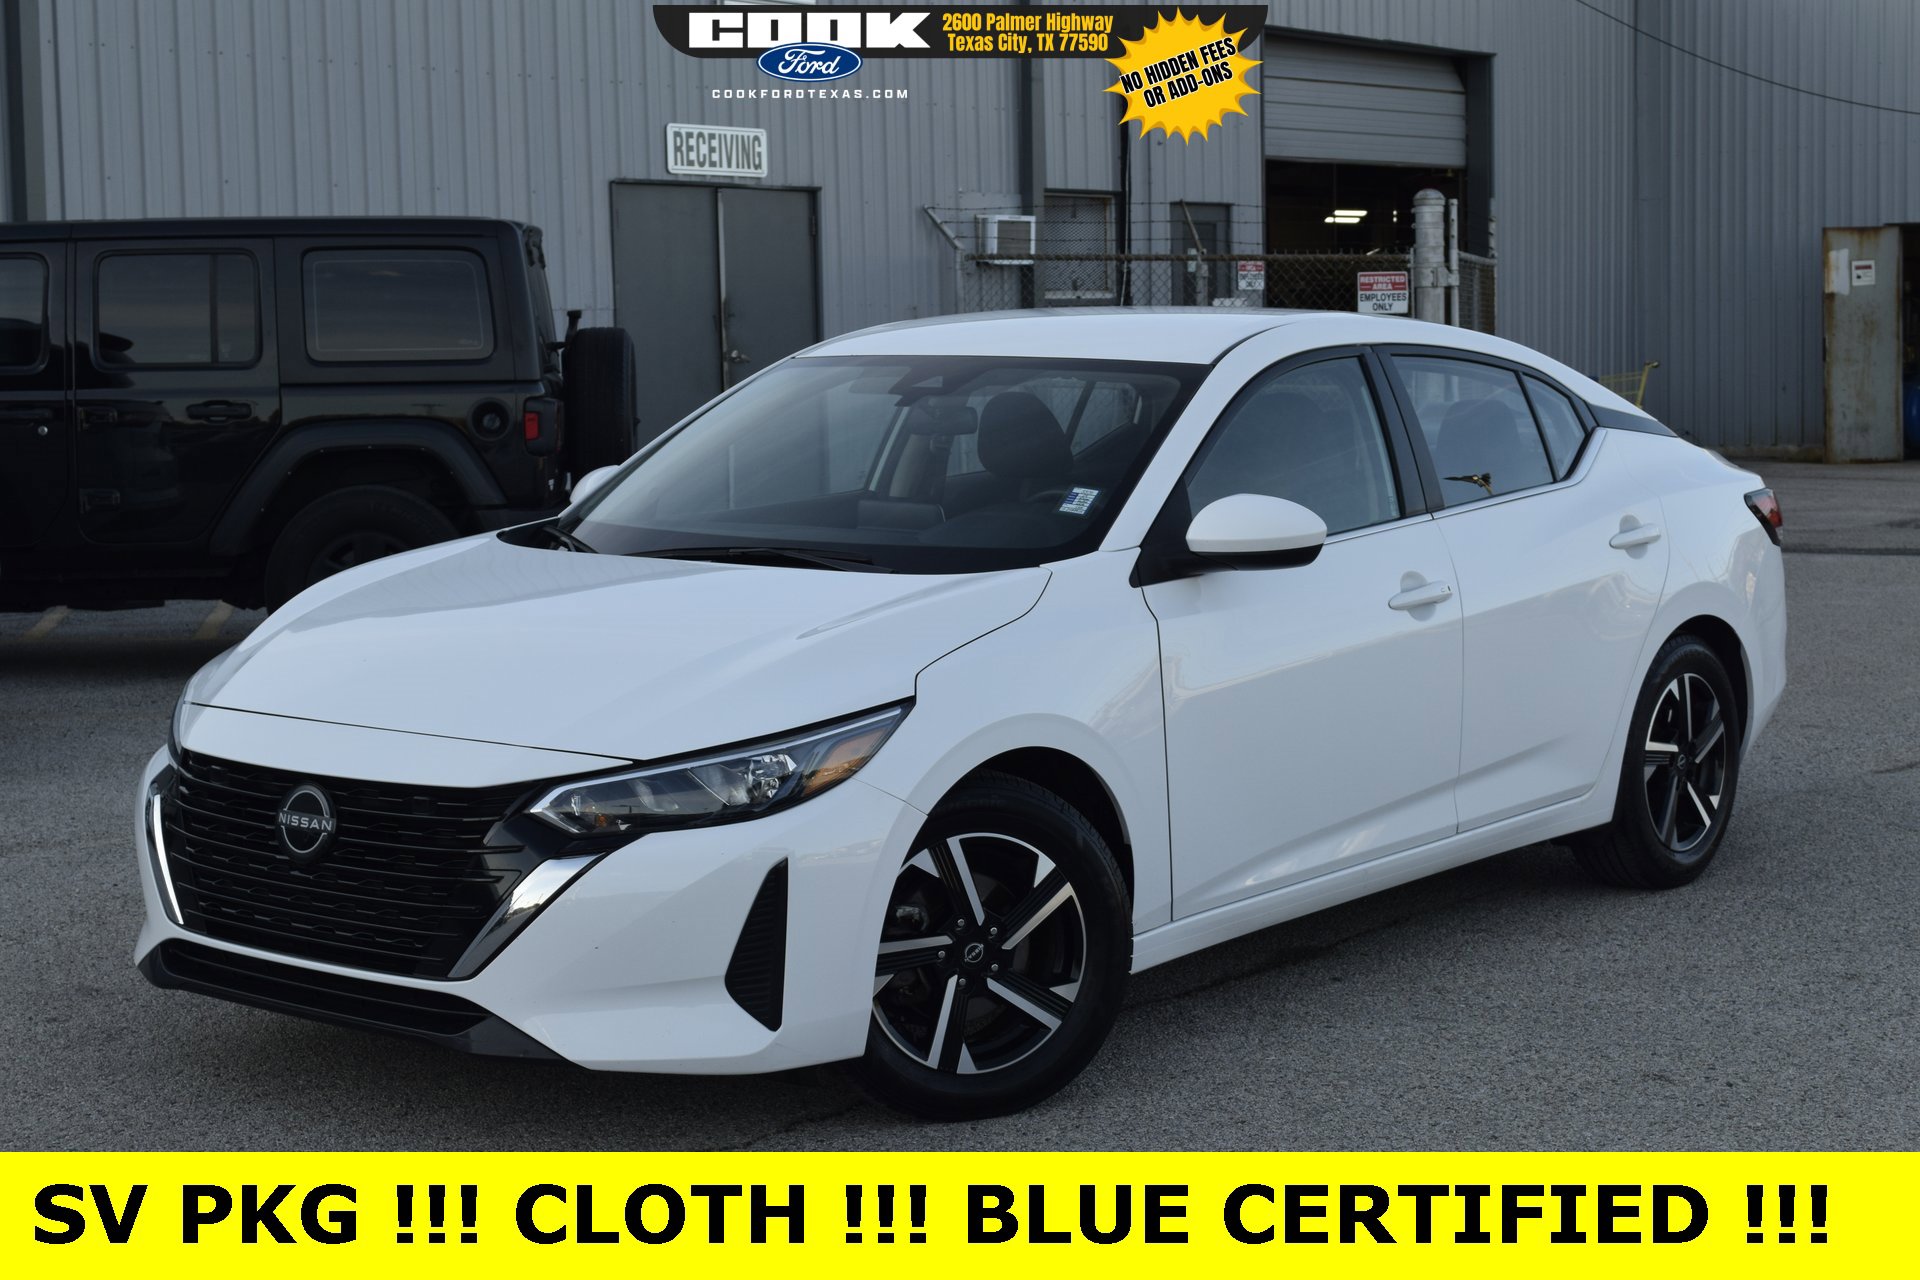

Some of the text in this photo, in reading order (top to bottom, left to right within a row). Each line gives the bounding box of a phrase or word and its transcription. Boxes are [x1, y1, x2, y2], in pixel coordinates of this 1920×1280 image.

[673, 130, 762, 170] RECEIVING
[1360, 293, 1407, 302] EMPLOYEES
[1372, 302, 1393, 311] ONLY
[279, 812, 332, 831] NISSAN
